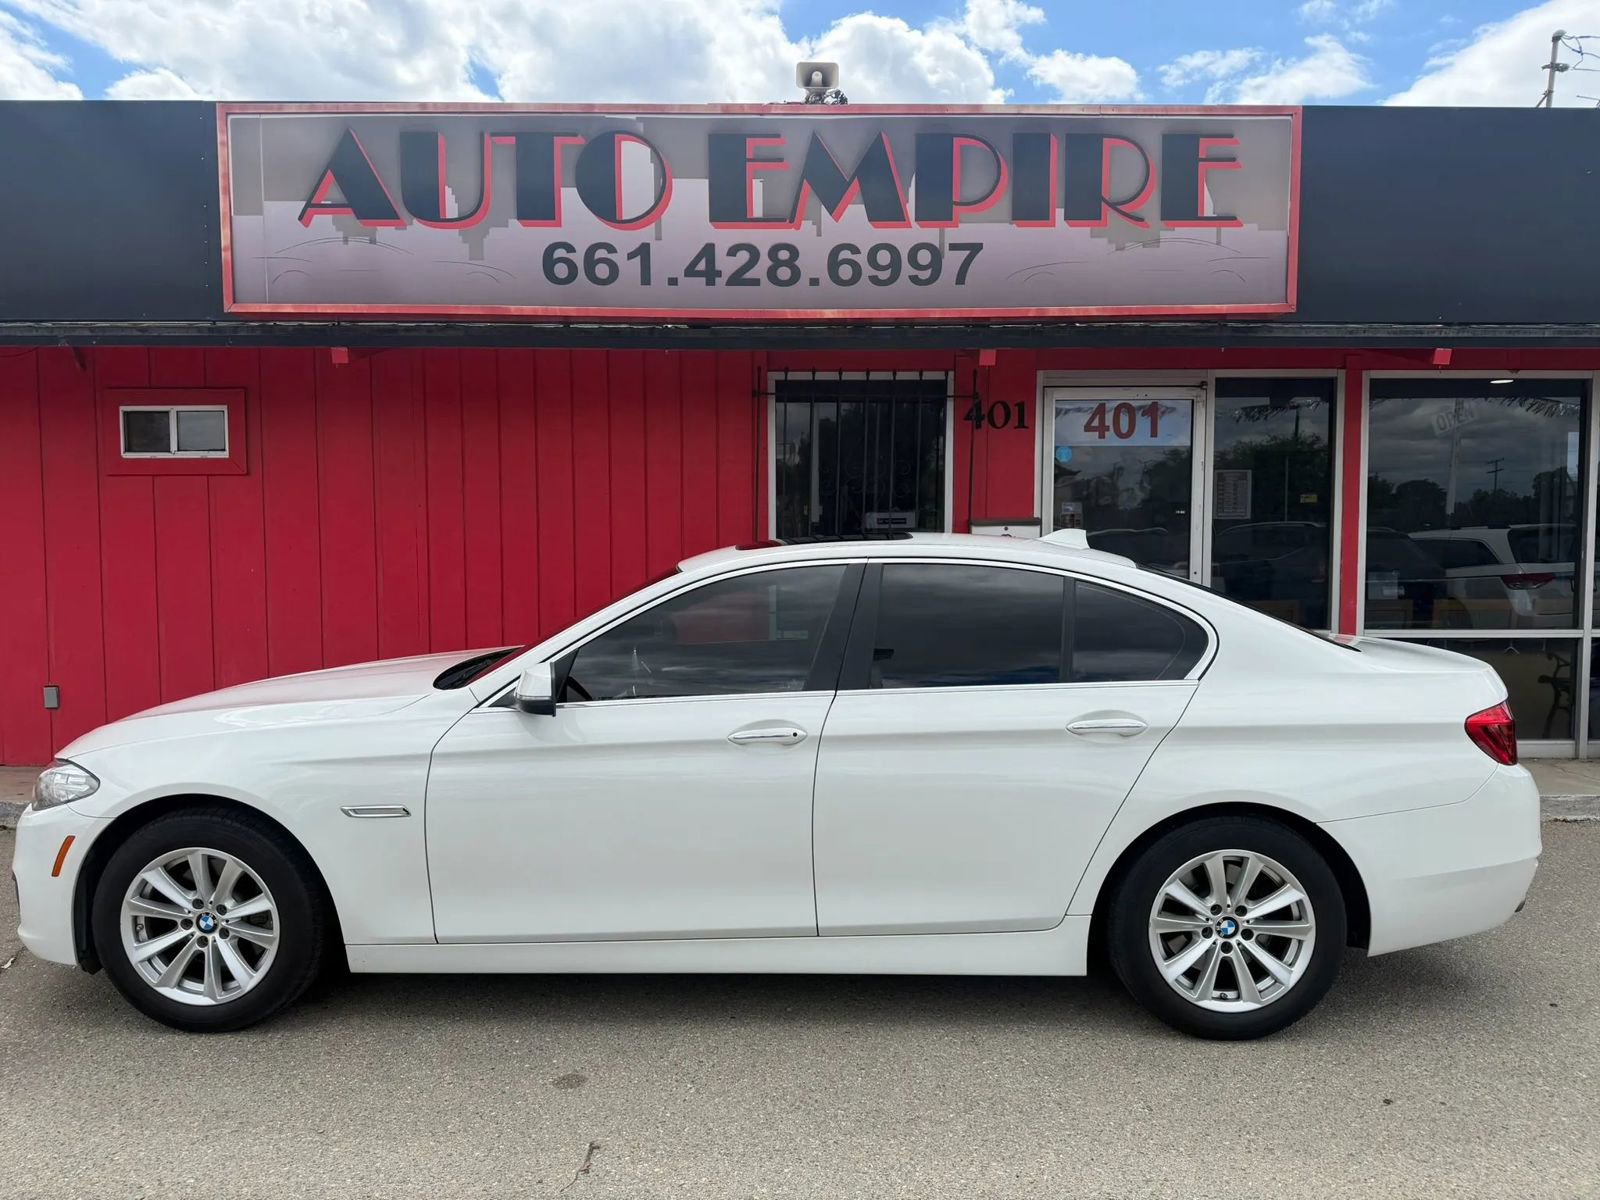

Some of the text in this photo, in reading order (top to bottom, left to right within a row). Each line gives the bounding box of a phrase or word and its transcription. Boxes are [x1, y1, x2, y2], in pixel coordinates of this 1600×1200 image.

[298, 128, 1243, 231] AUTO EMPIRE
[541, 240, 984, 287] 661.428.6997
[963, 398, 1029, 430] 401
[1083, 401, 1160, 440] 401
